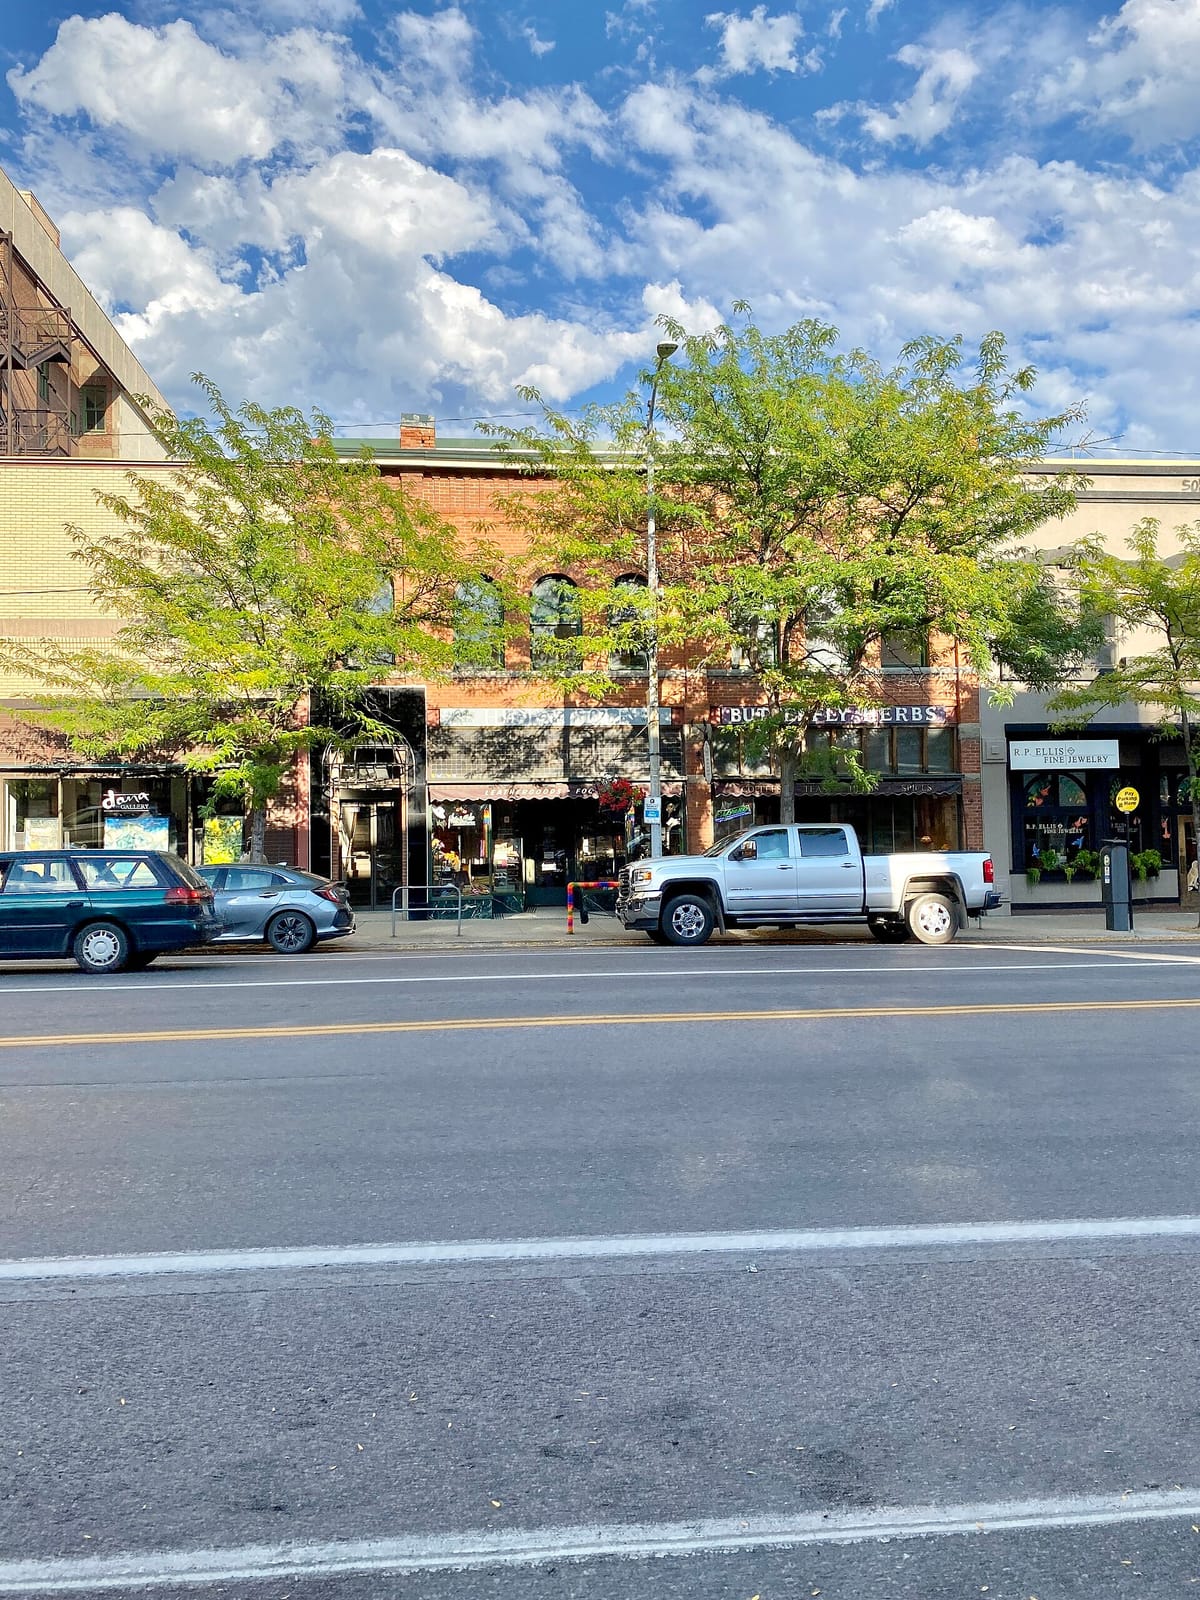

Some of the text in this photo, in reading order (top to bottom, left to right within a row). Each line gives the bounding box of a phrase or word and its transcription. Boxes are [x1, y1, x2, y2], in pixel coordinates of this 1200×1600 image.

[1182, 479, 1200, 492] 50
[863, 706, 938, 722] HERBS
[1035, 747, 1064, 756] ELLIS
[1044, 755, 1109, 764] FINE JEWELRY
[484, 788, 563, 796] LEATHERGOODS
[102, 789, 150, 810] dana
